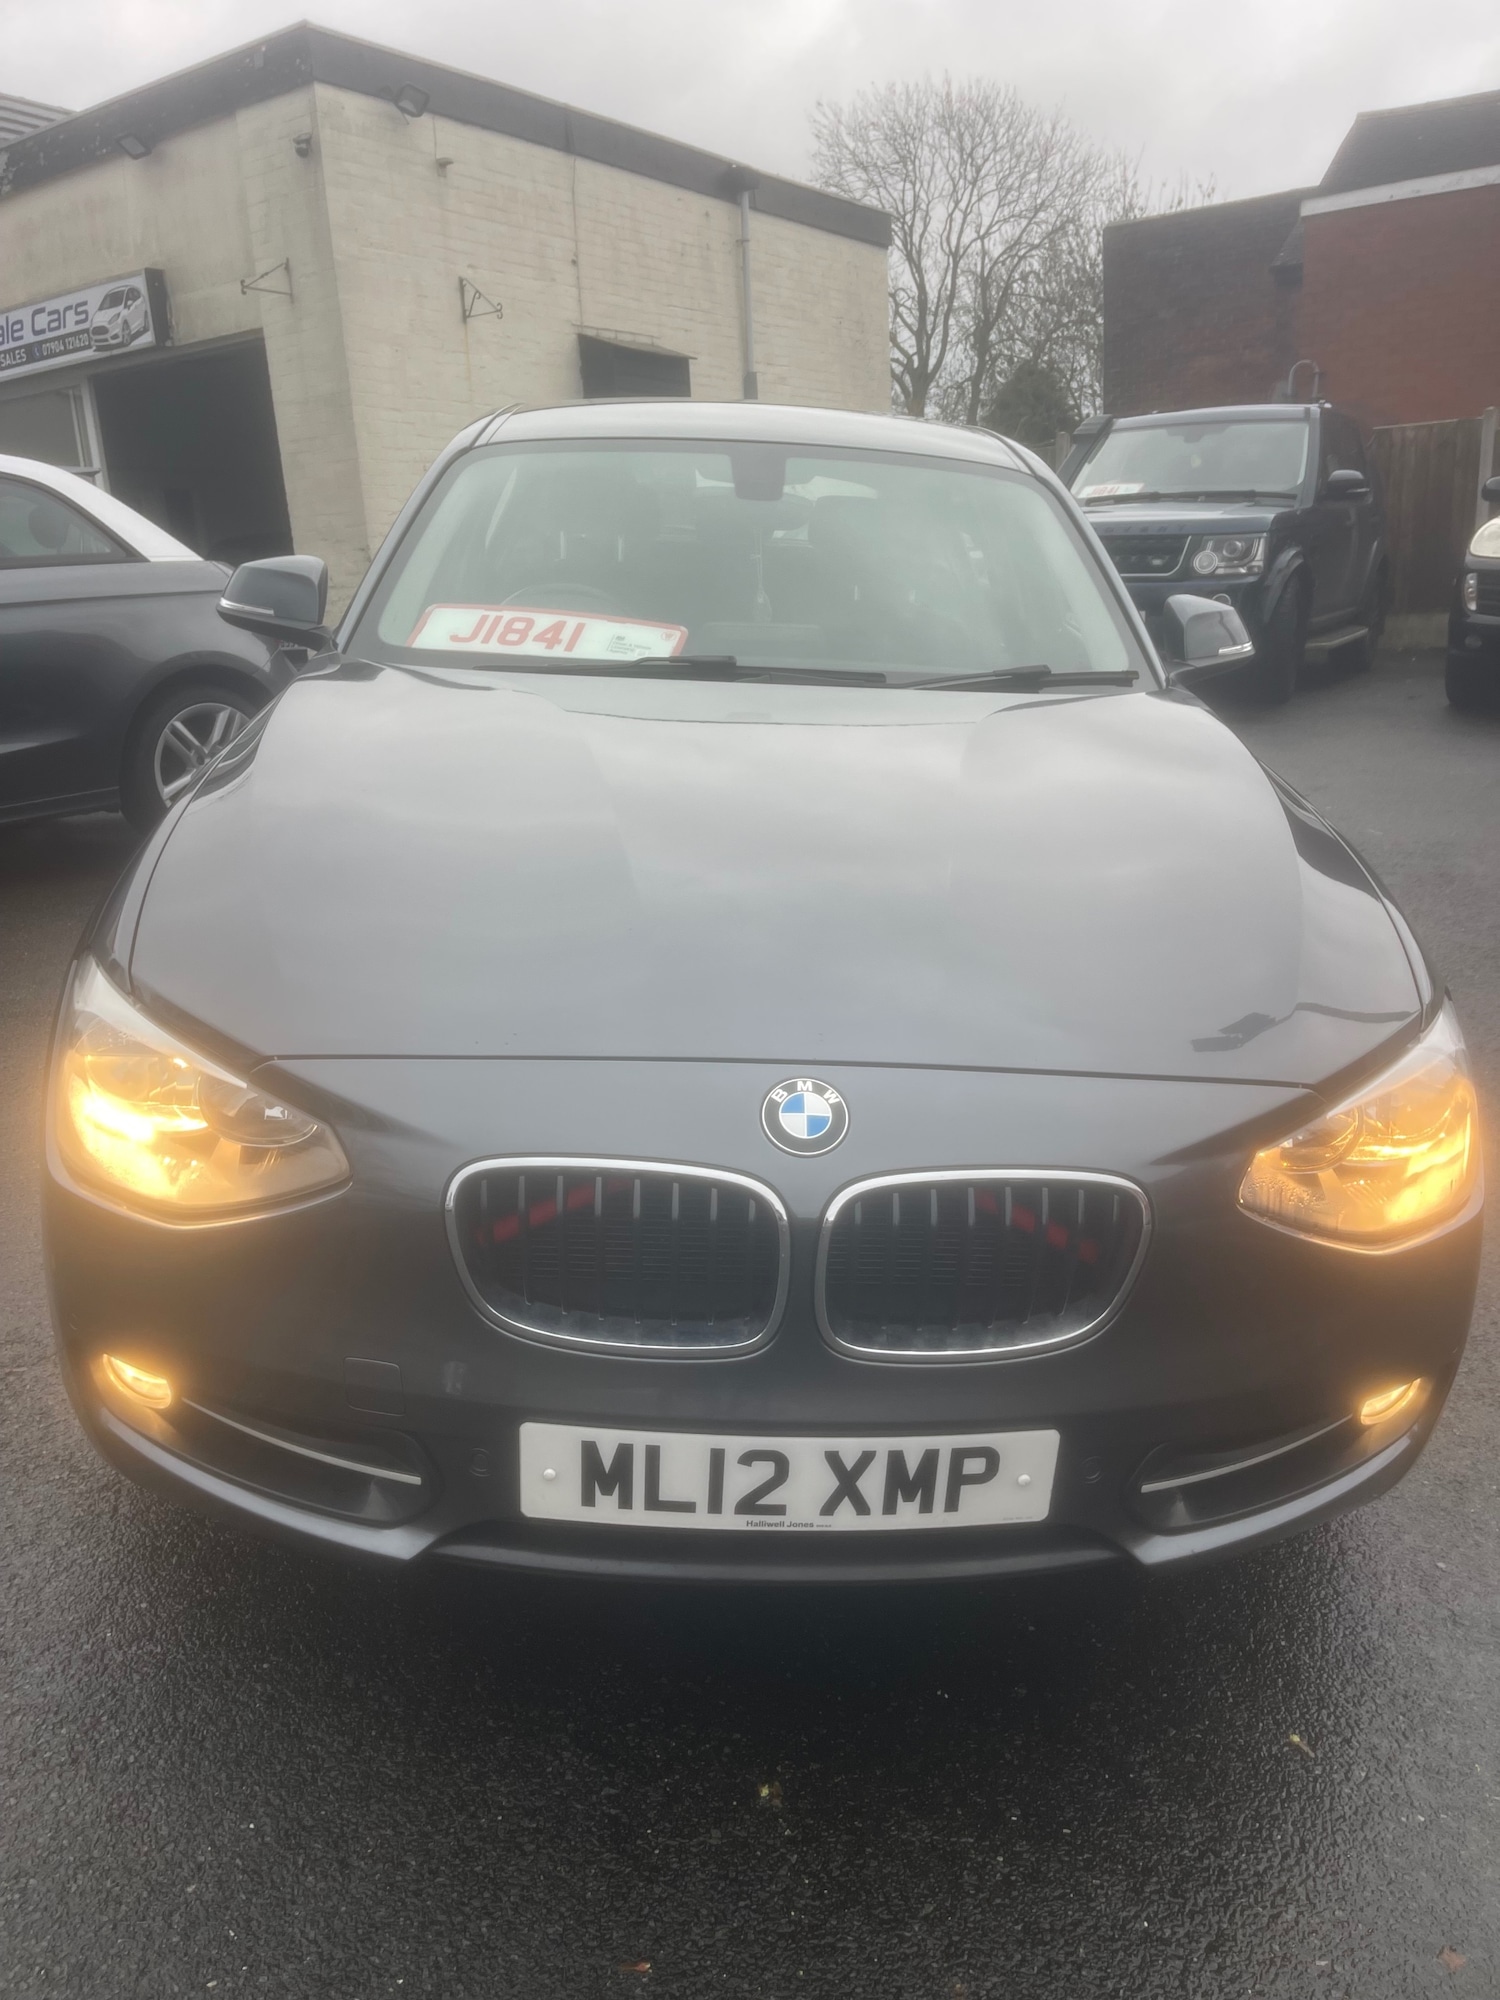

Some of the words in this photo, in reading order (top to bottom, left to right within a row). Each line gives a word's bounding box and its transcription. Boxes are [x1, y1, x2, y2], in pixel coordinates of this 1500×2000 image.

[31, 300, 89, 336] Cars
[0, 348, 27, 367] SALES
[771, 1080, 840, 1104] BMW
[580, 1440, 790, 1516] ML12
[819, 1445, 1001, 1517] XMP
[746, 1520, 785, 1528] Halliwell
[786, 1520, 814, 1528] Jones
